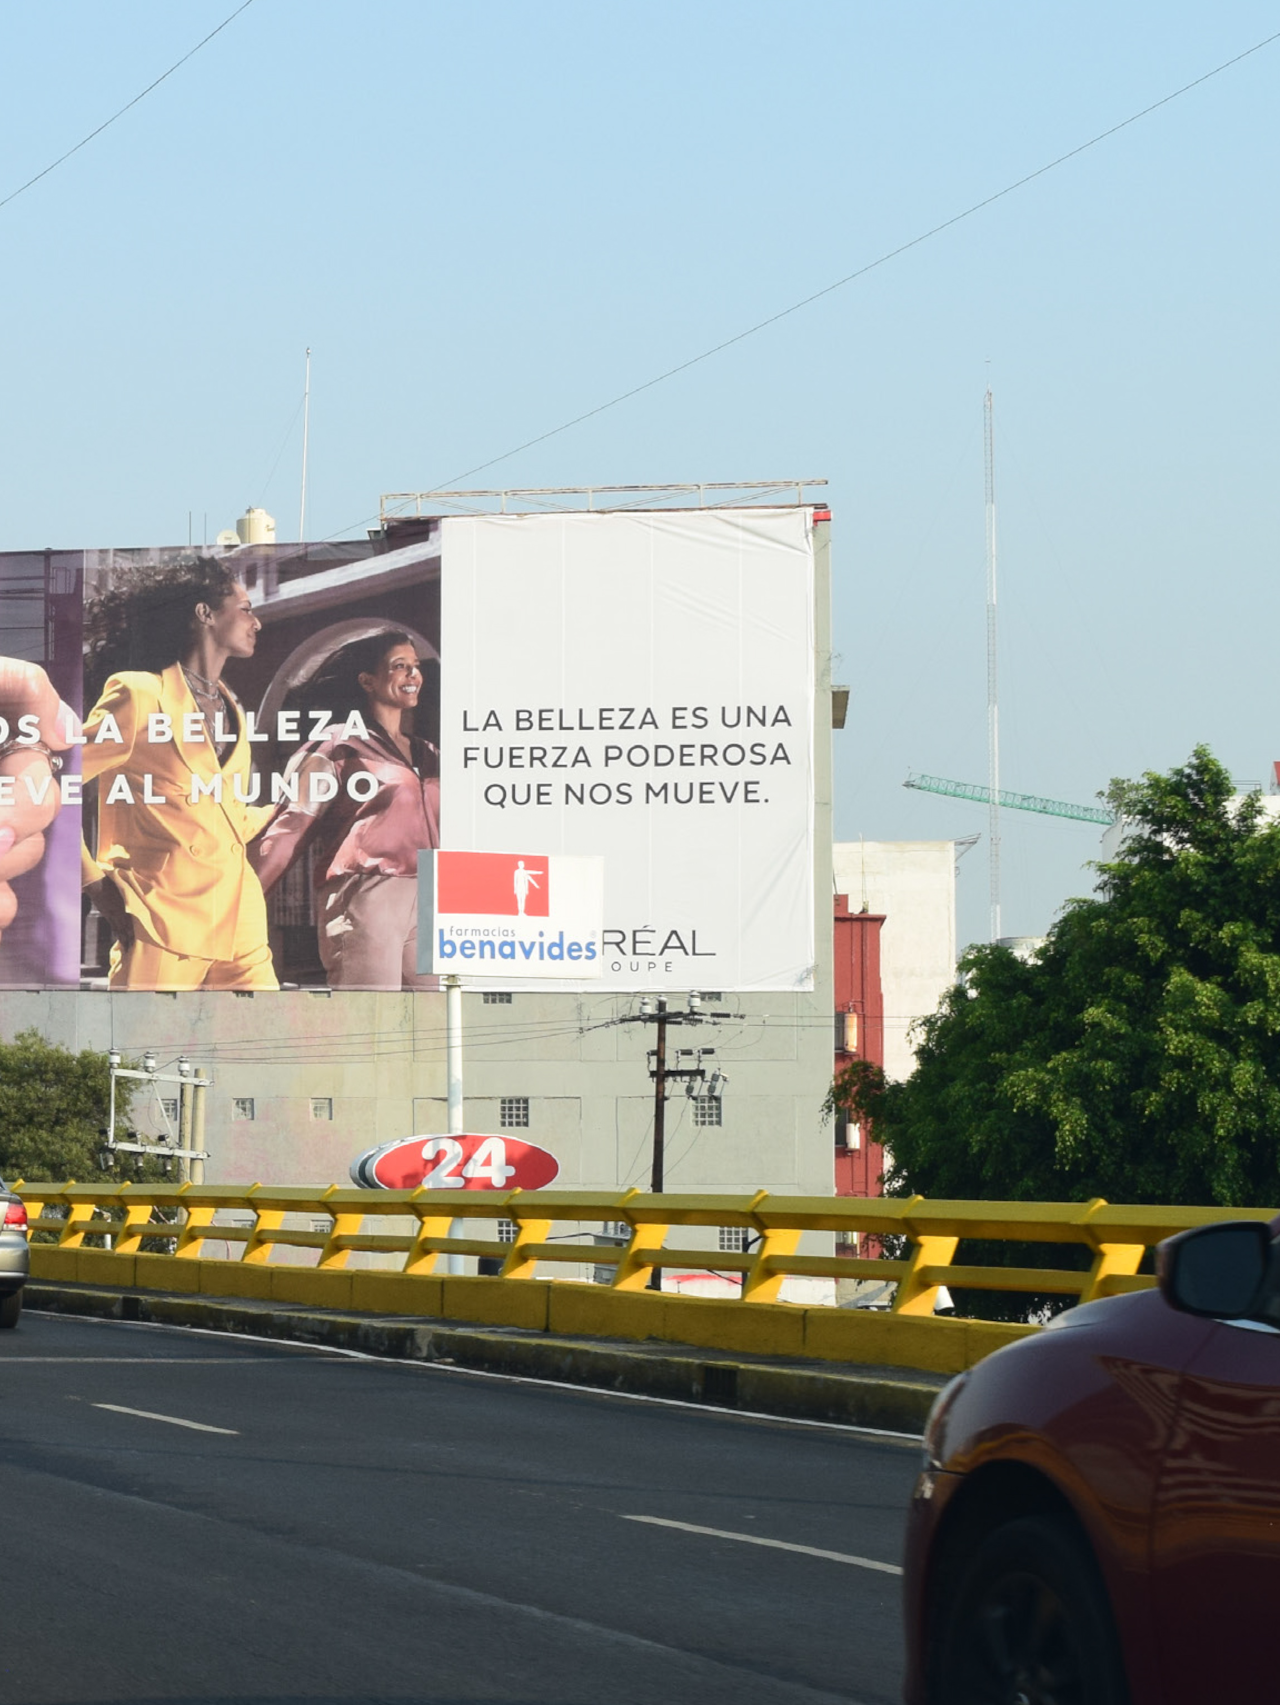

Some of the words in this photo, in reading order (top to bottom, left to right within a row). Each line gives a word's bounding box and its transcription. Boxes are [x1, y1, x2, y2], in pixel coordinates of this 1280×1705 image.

[65, 712, 124, 746] LA
[147, 709, 370, 744] BELLEZA
[463, 709, 503, 732] LA
[515, 707, 659, 731] BELLEZA
[671, 706, 708, 730] ES
[721, 705, 792, 729] UNA
[463, 746, 592, 769] FUERZA
[604, 742, 792, 768] PODEROSA
[106, 773, 166, 805] AL
[191, 770, 379, 804] MUNDO
[484, 783, 553, 809] QUE
[564, 782, 633, 806] NOS
[645, 780, 769, 805] MUEVE.
[438, 928, 597, 961] benavides
[449, 926, 516, 938] farmacias
[602, 925, 717, 957] RÉAL
[611, 961, 673, 972] OUPE
[421, 1137, 516, 1189] 24
